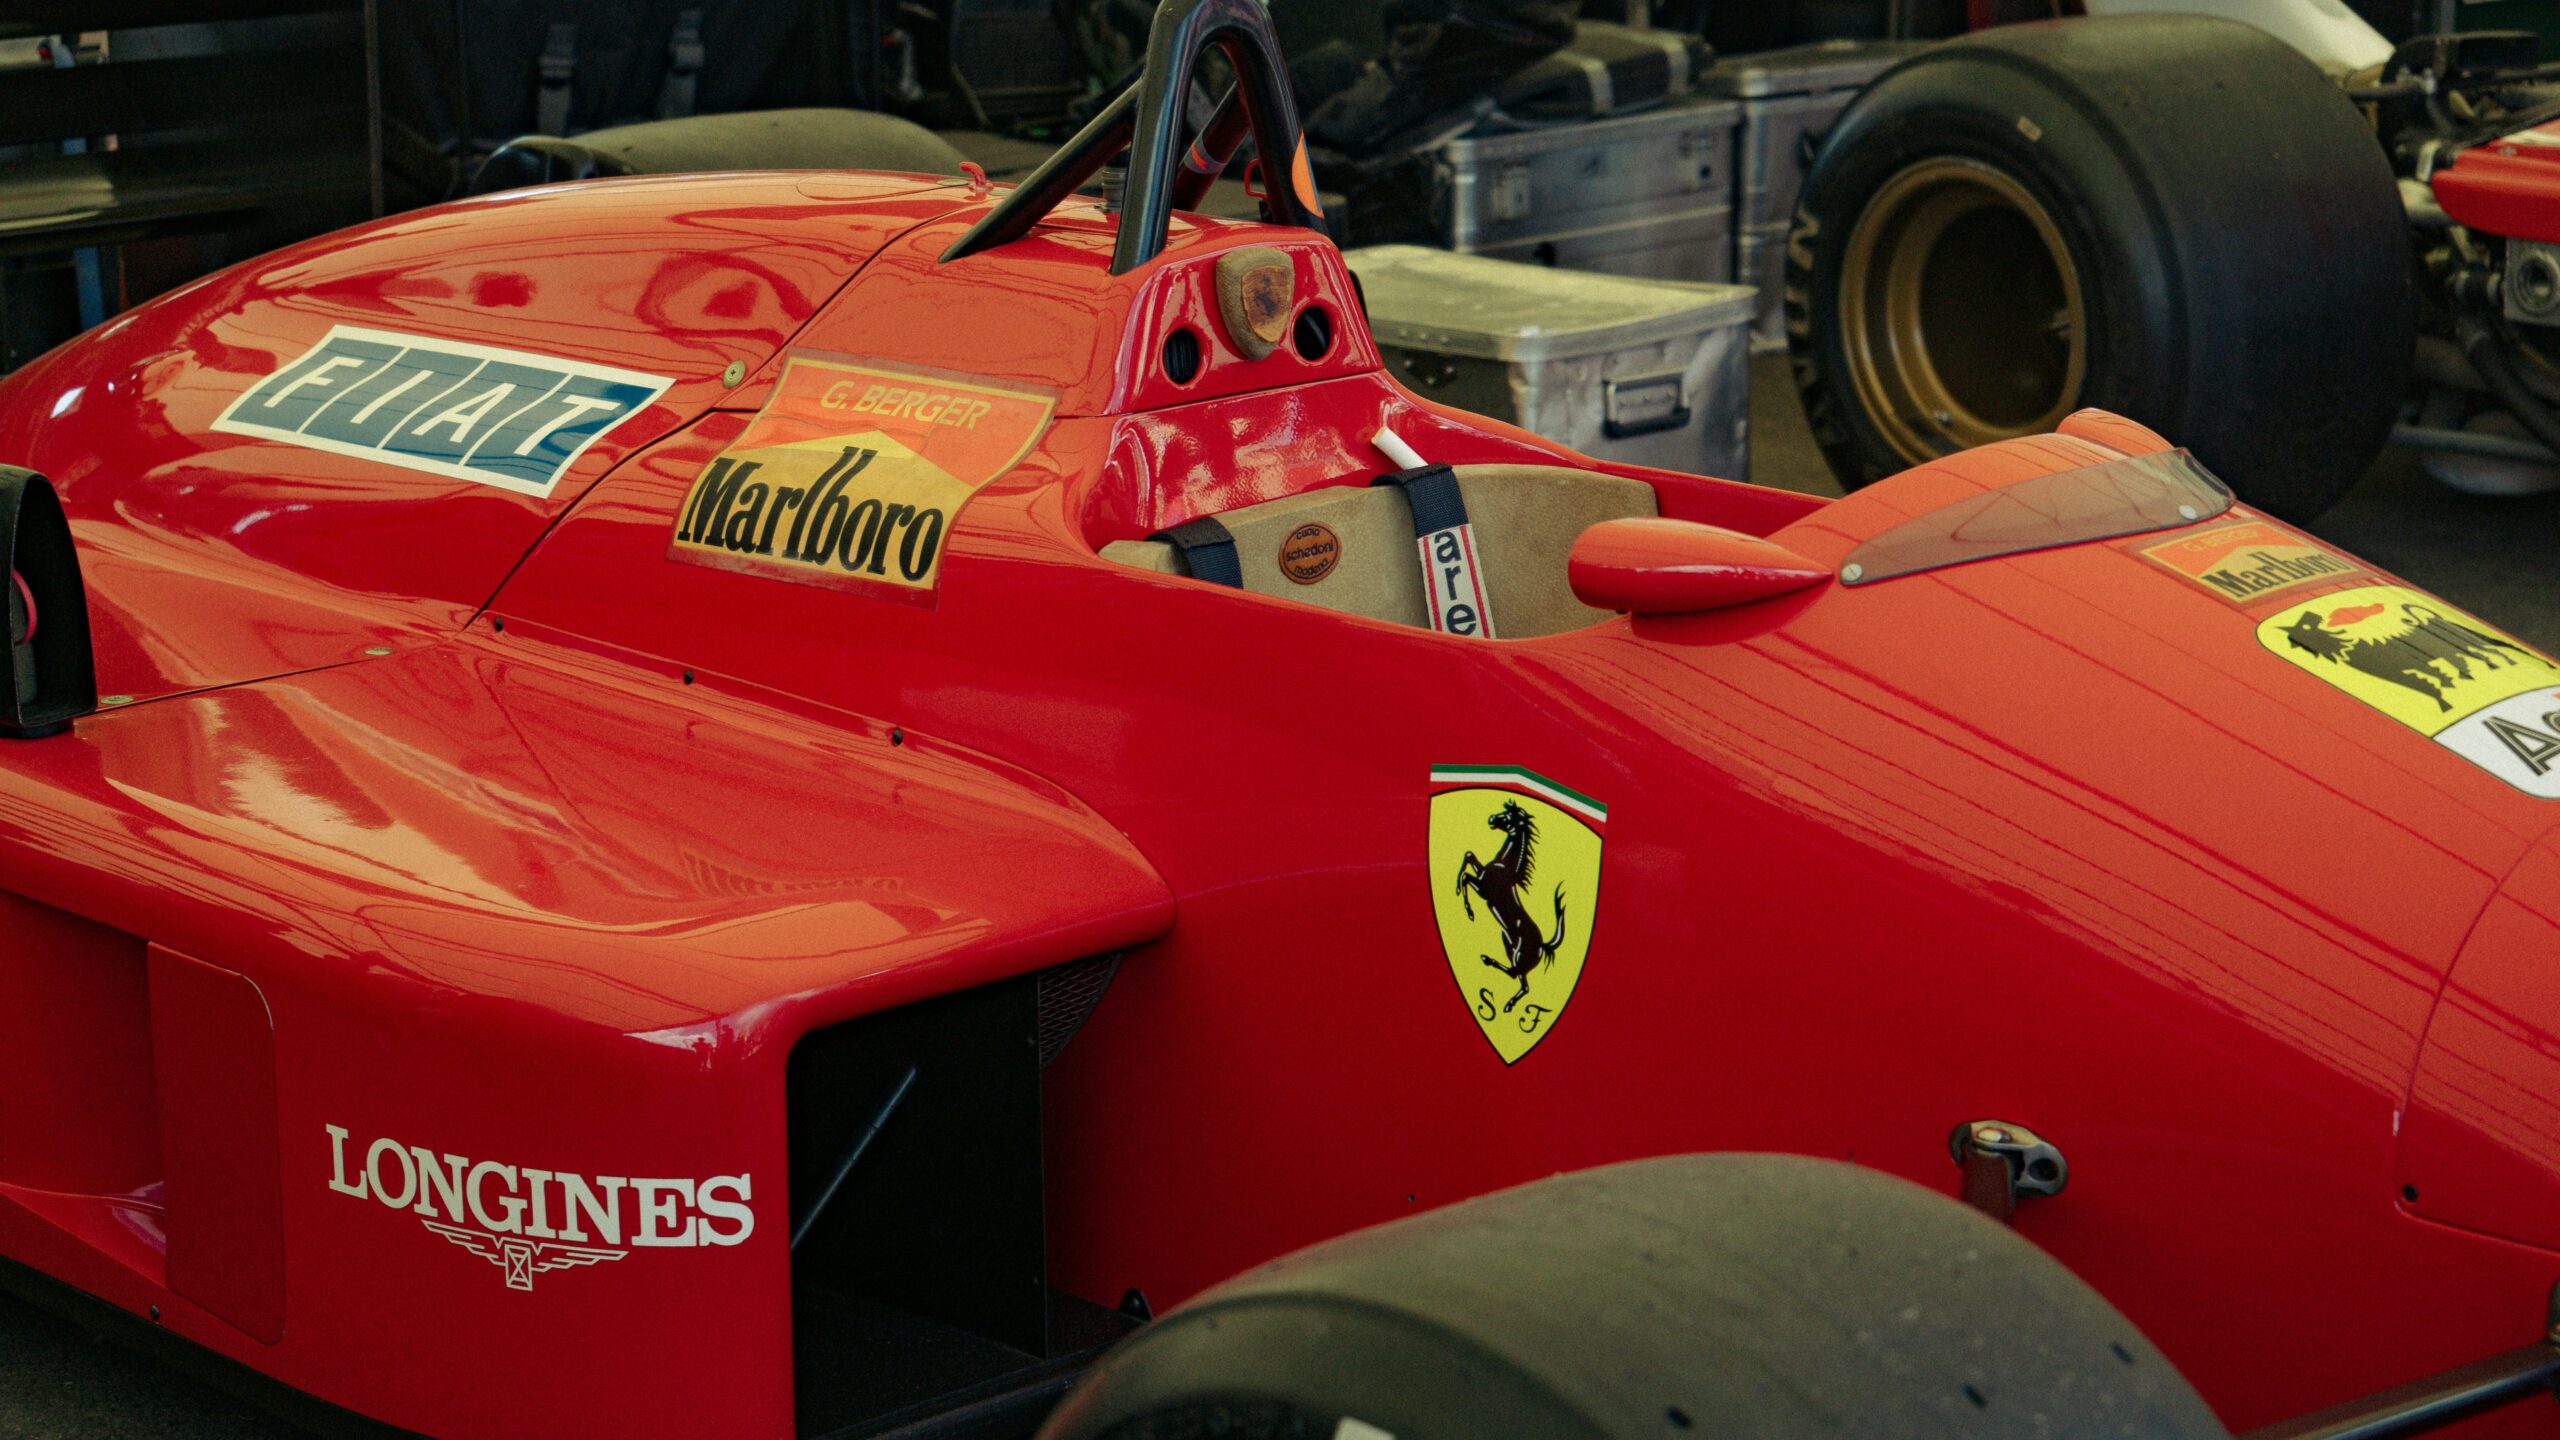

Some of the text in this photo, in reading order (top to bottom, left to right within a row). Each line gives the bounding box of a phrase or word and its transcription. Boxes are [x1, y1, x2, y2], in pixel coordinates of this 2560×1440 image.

[263, 356, 621, 456] FIAT
[819, 380, 992, 430] G. BERGER
[677, 446, 944, 582] Marlboro
[2201, 551, 2351, 598] Marlboro
[2482, 709, 2560, 777] A
[1477, 987, 1553, 1034] S F
[325, 1122, 755, 1247] LONGINES
